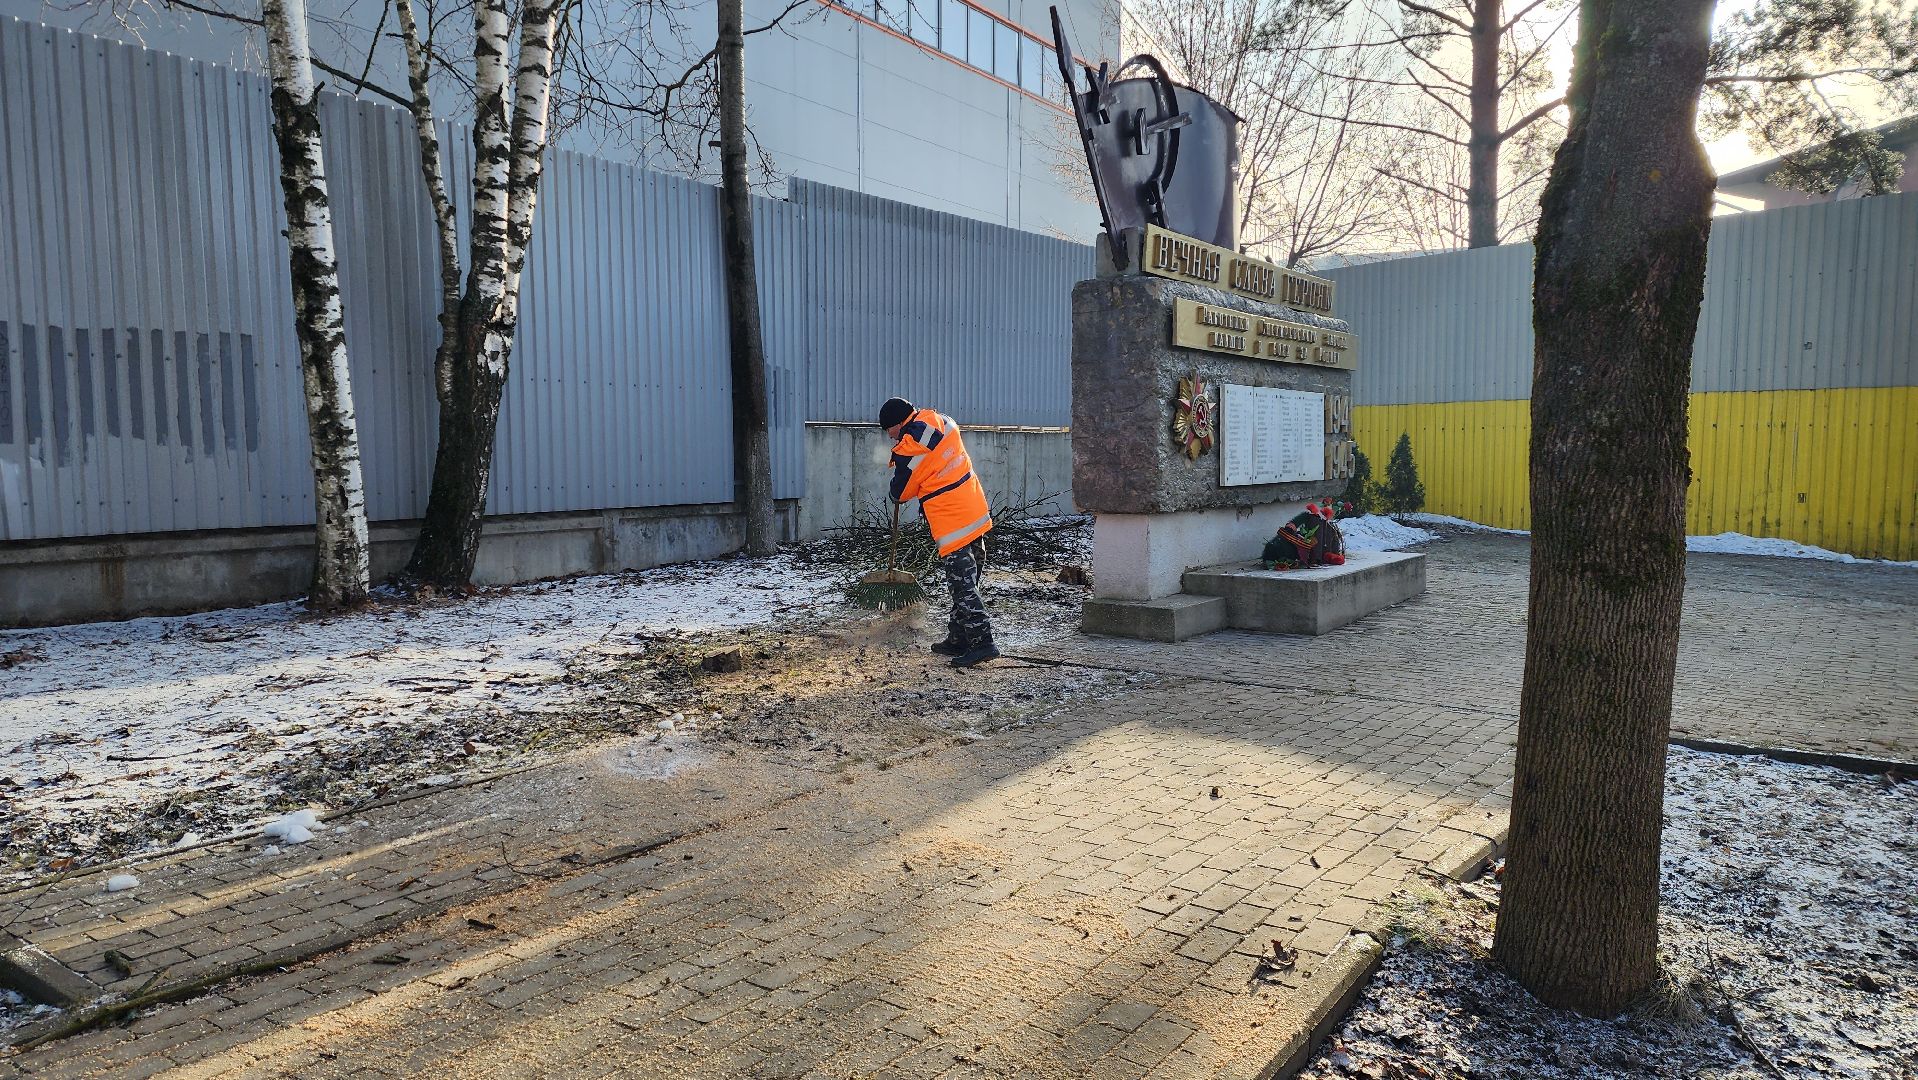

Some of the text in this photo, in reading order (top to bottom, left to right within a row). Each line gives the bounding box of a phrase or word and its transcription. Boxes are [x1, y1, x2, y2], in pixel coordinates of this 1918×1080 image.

[1154, 234, 1333, 311] ВЕЧНАЯ СЛАВА ГЕРОЯМ
[1326, 440, 1356, 480] 1945
